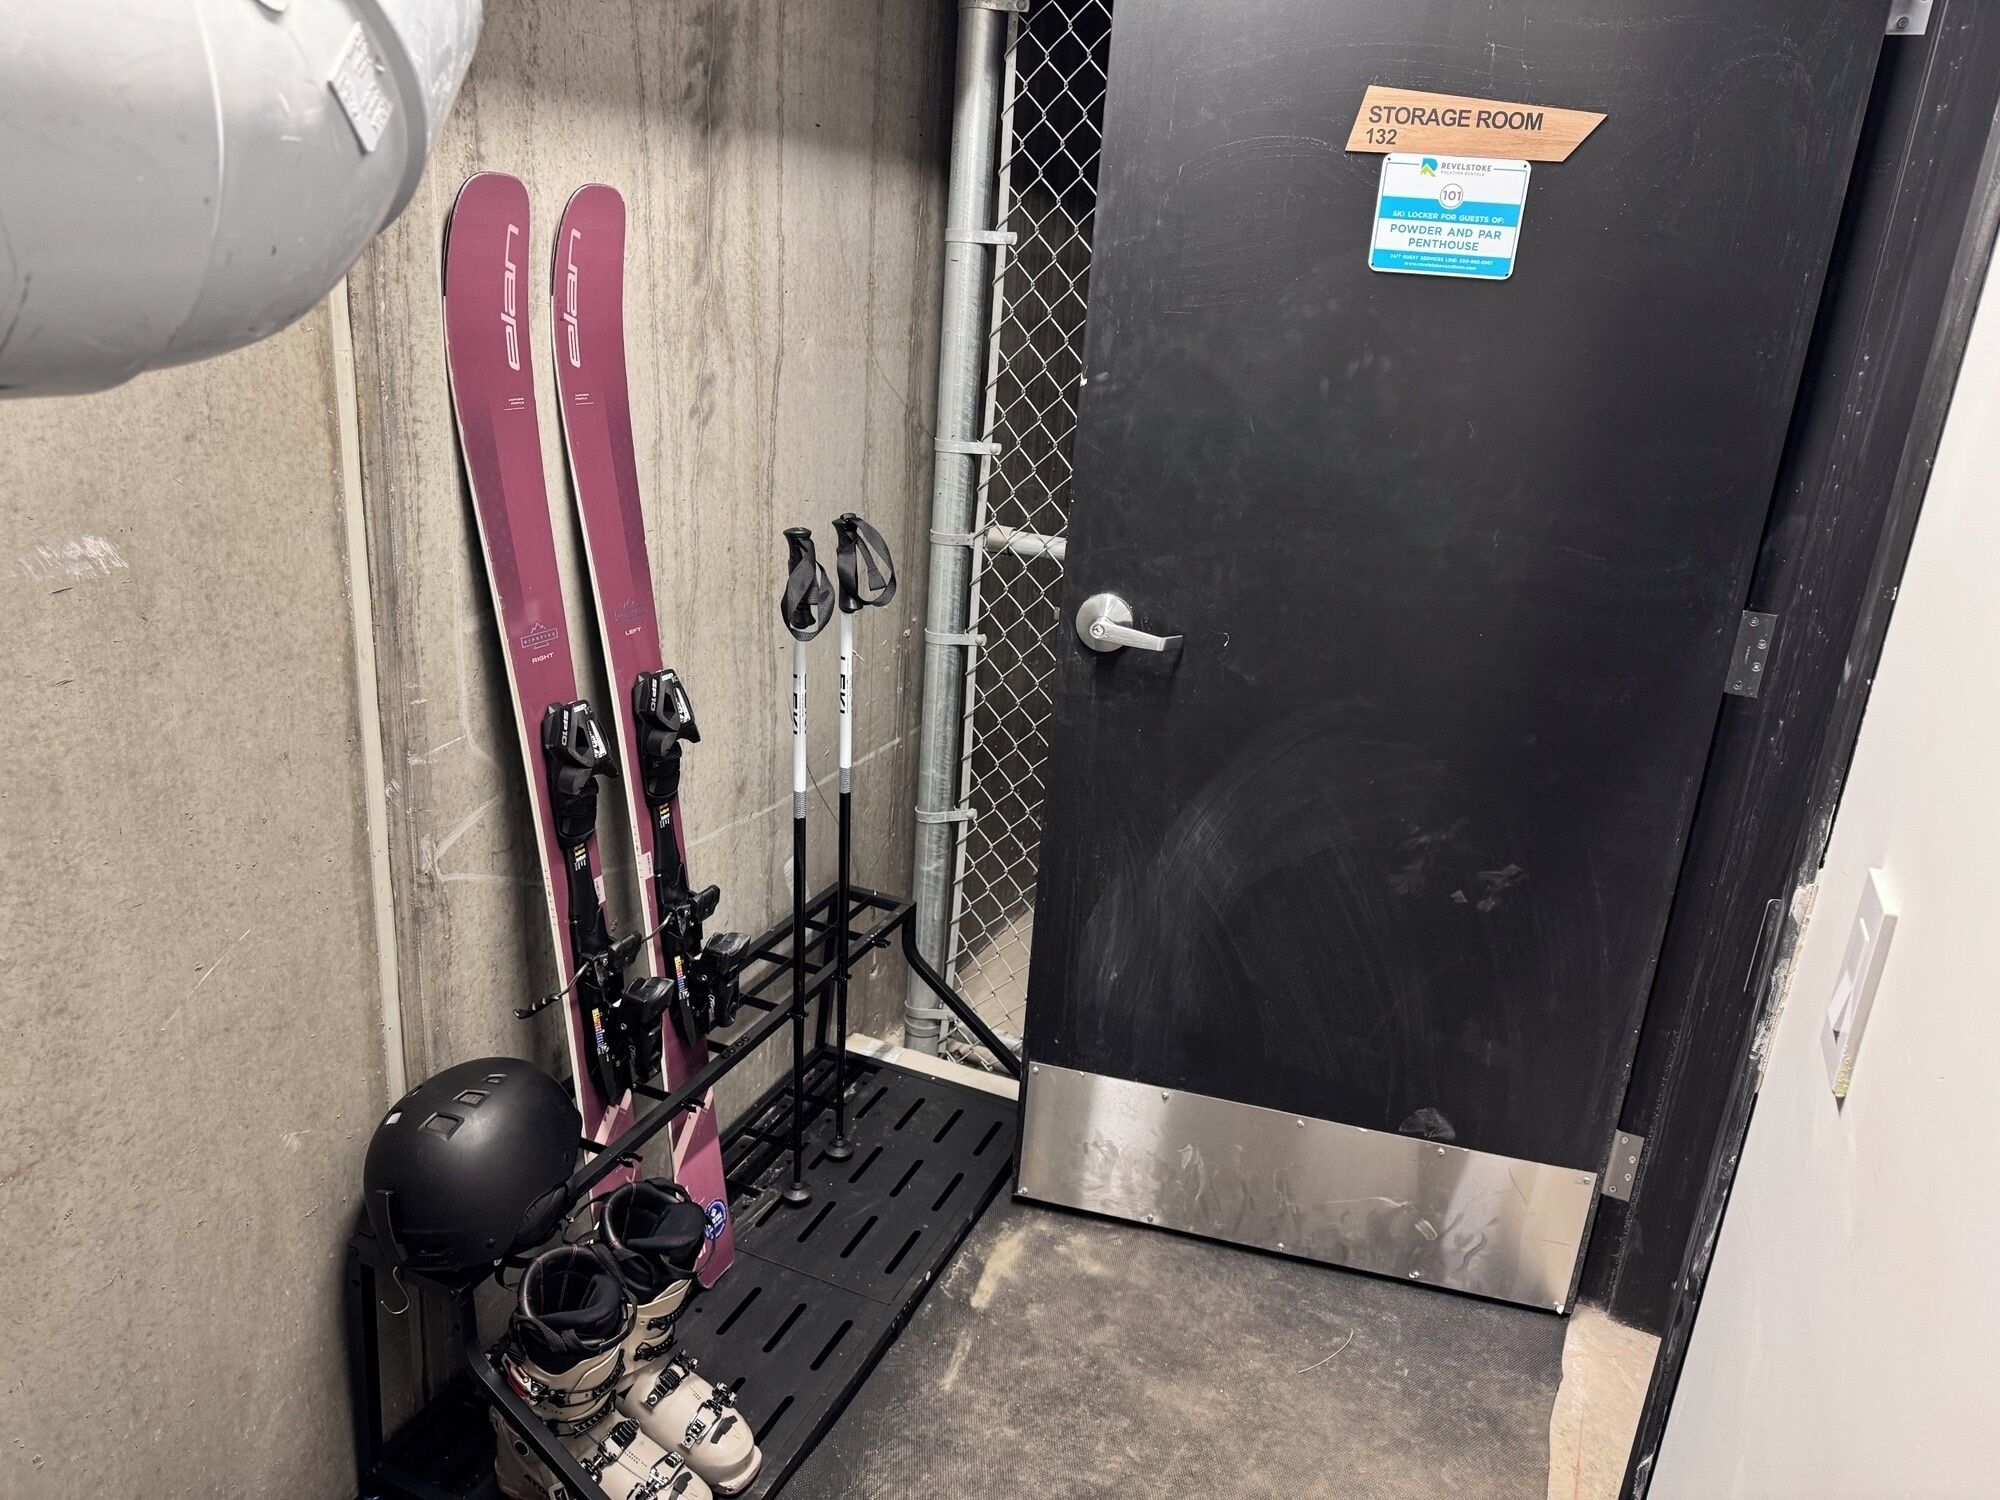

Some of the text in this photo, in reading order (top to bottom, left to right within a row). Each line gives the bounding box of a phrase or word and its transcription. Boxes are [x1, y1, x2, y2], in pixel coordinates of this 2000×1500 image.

[1368, 105, 1544, 131] STORAGE ROOM
[1365, 127, 1398, 146] 132
[1441, 162, 1492, 172] REVELSTOKE
[1442, 190, 1462, 201] 101
[1407, 211, 1439, 219] LOCKER
[1459, 214, 1489, 223] GUESTS
[1491, 216, 1505, 224] OF:
[1390, 223, 1502, 240] POWDER AND PAR
[1408, 237, 1480, 251] PENTHOUSE
[500, 223, 521, 372] elan
[562, 228, 582, 369] elan
[625, 626, 642, 636] LEFT
[531, 652, 555, 664] RIGHT
